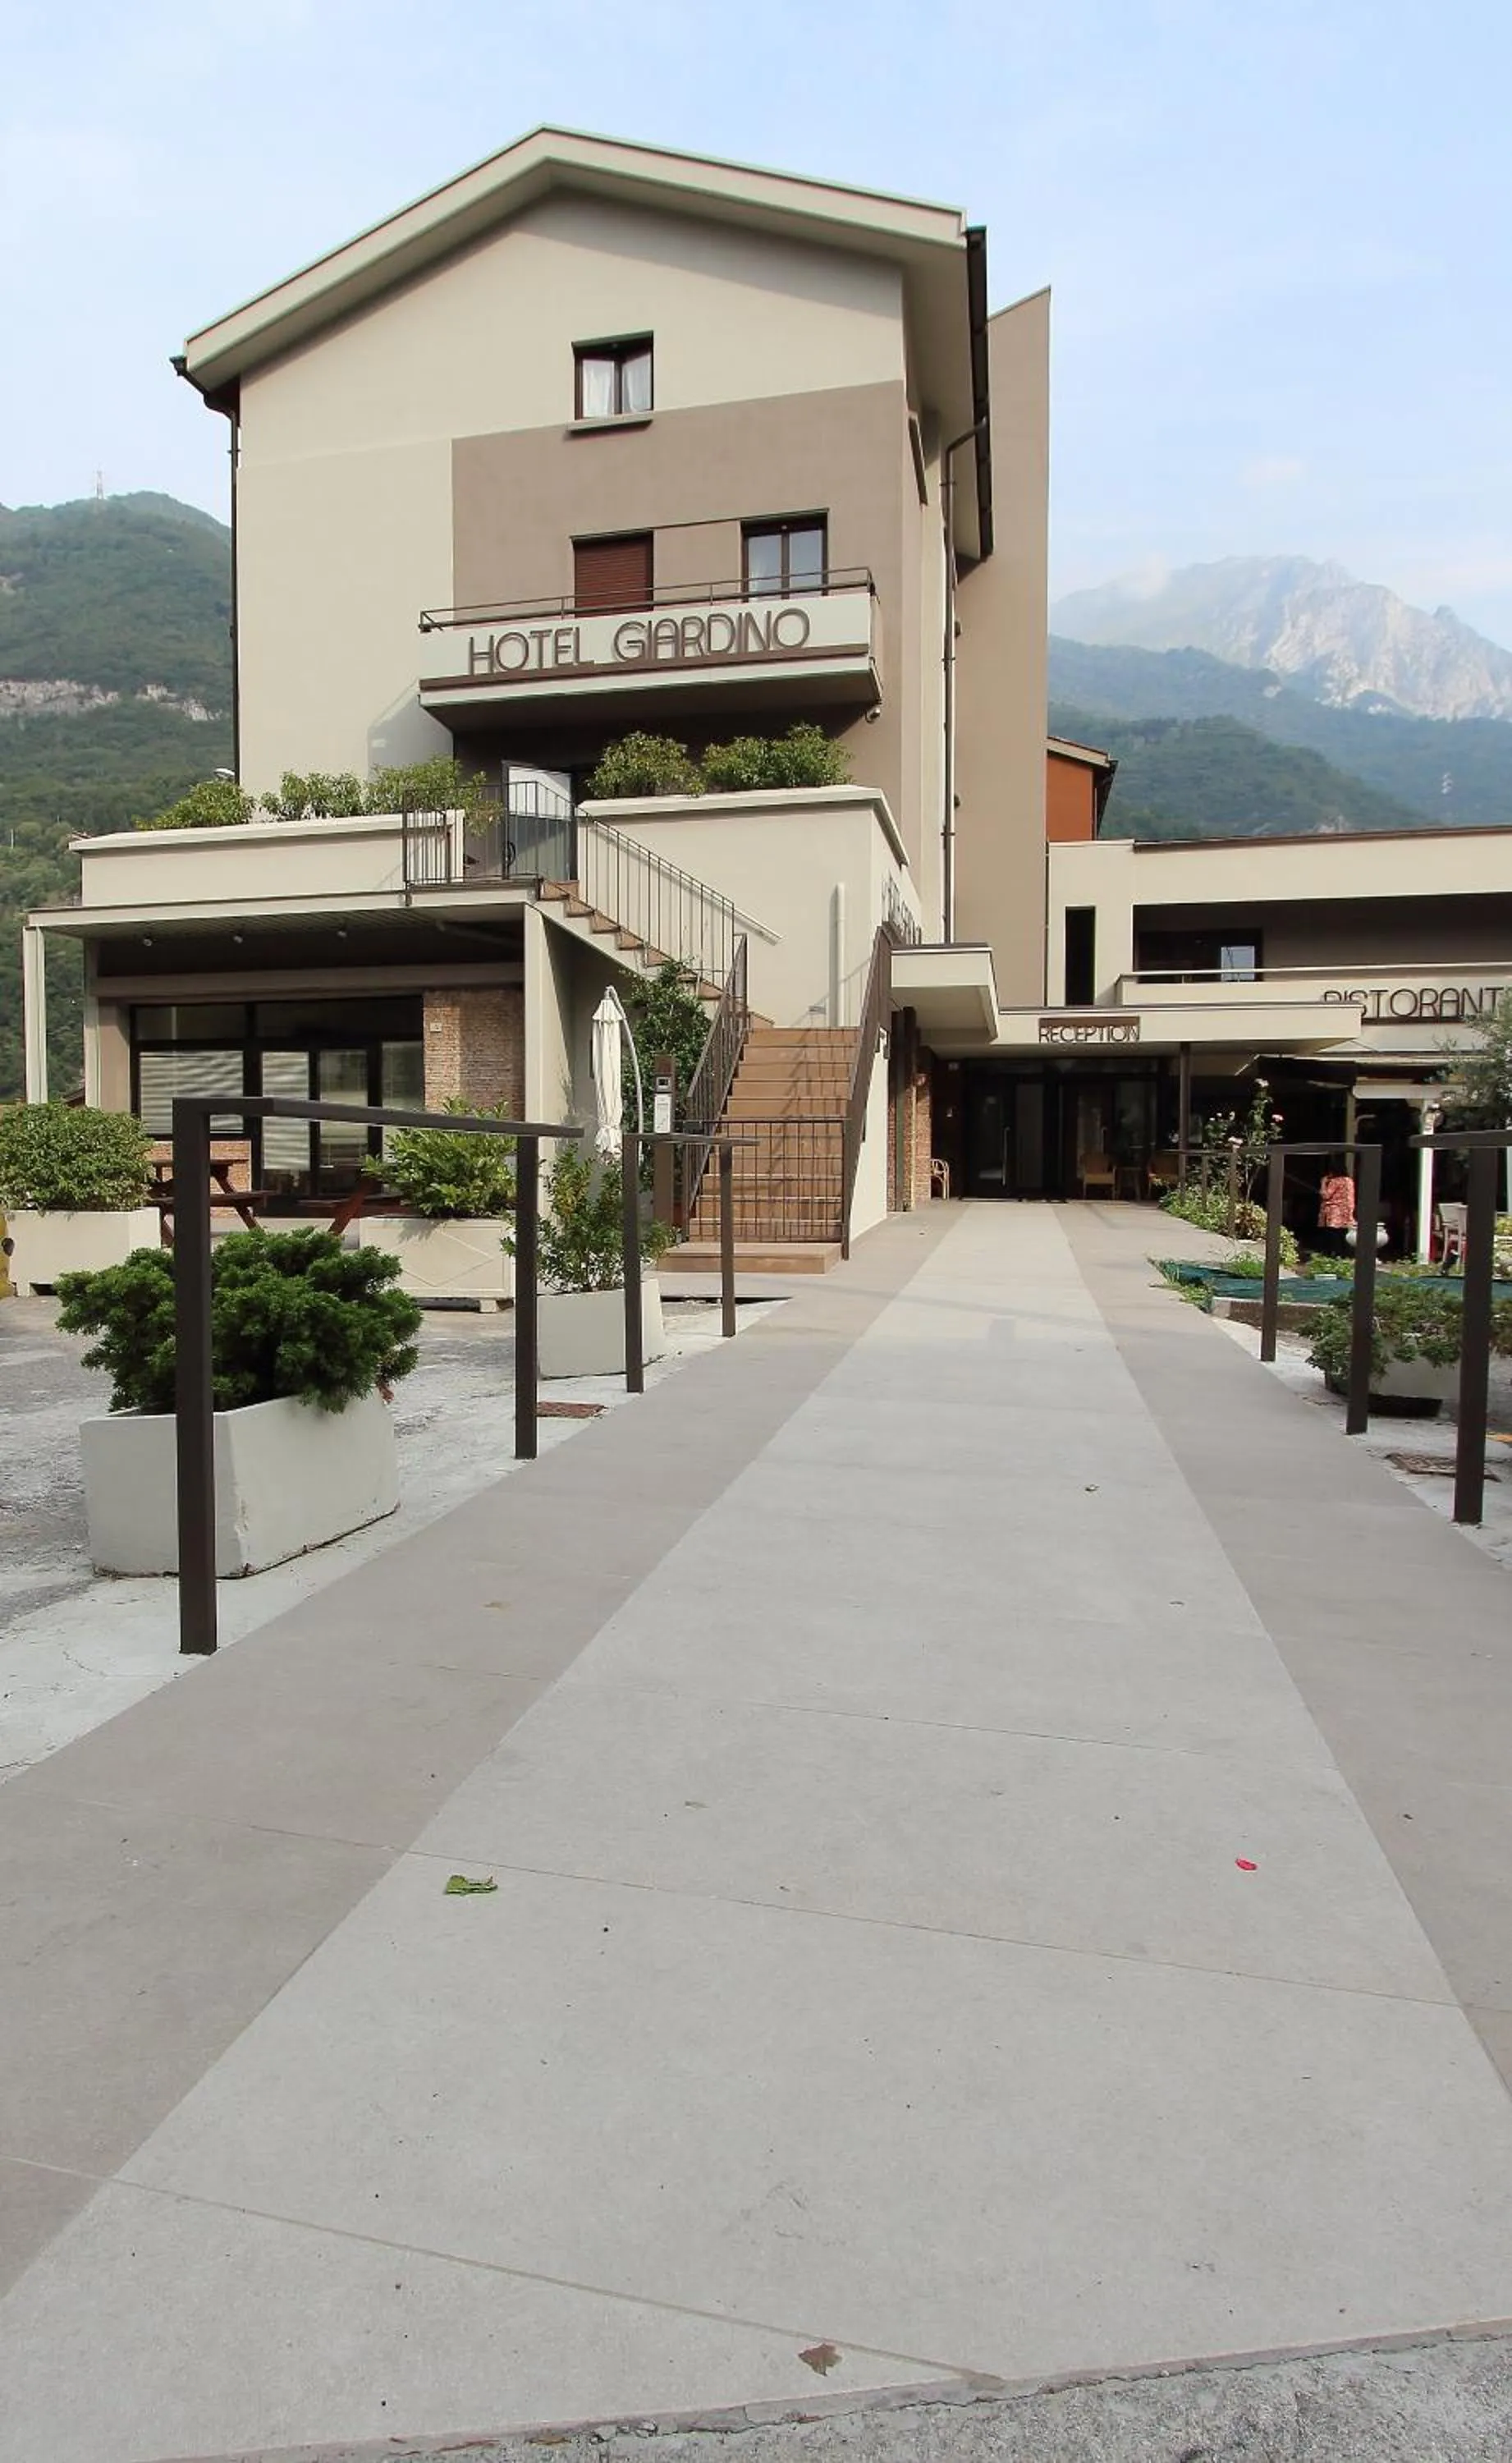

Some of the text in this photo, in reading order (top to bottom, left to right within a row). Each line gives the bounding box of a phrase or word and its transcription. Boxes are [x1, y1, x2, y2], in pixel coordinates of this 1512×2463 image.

[470, 608, 810, 675] HOTEL GIARDINO
[1038, 1025, 1140, 1043] RECEPTION
